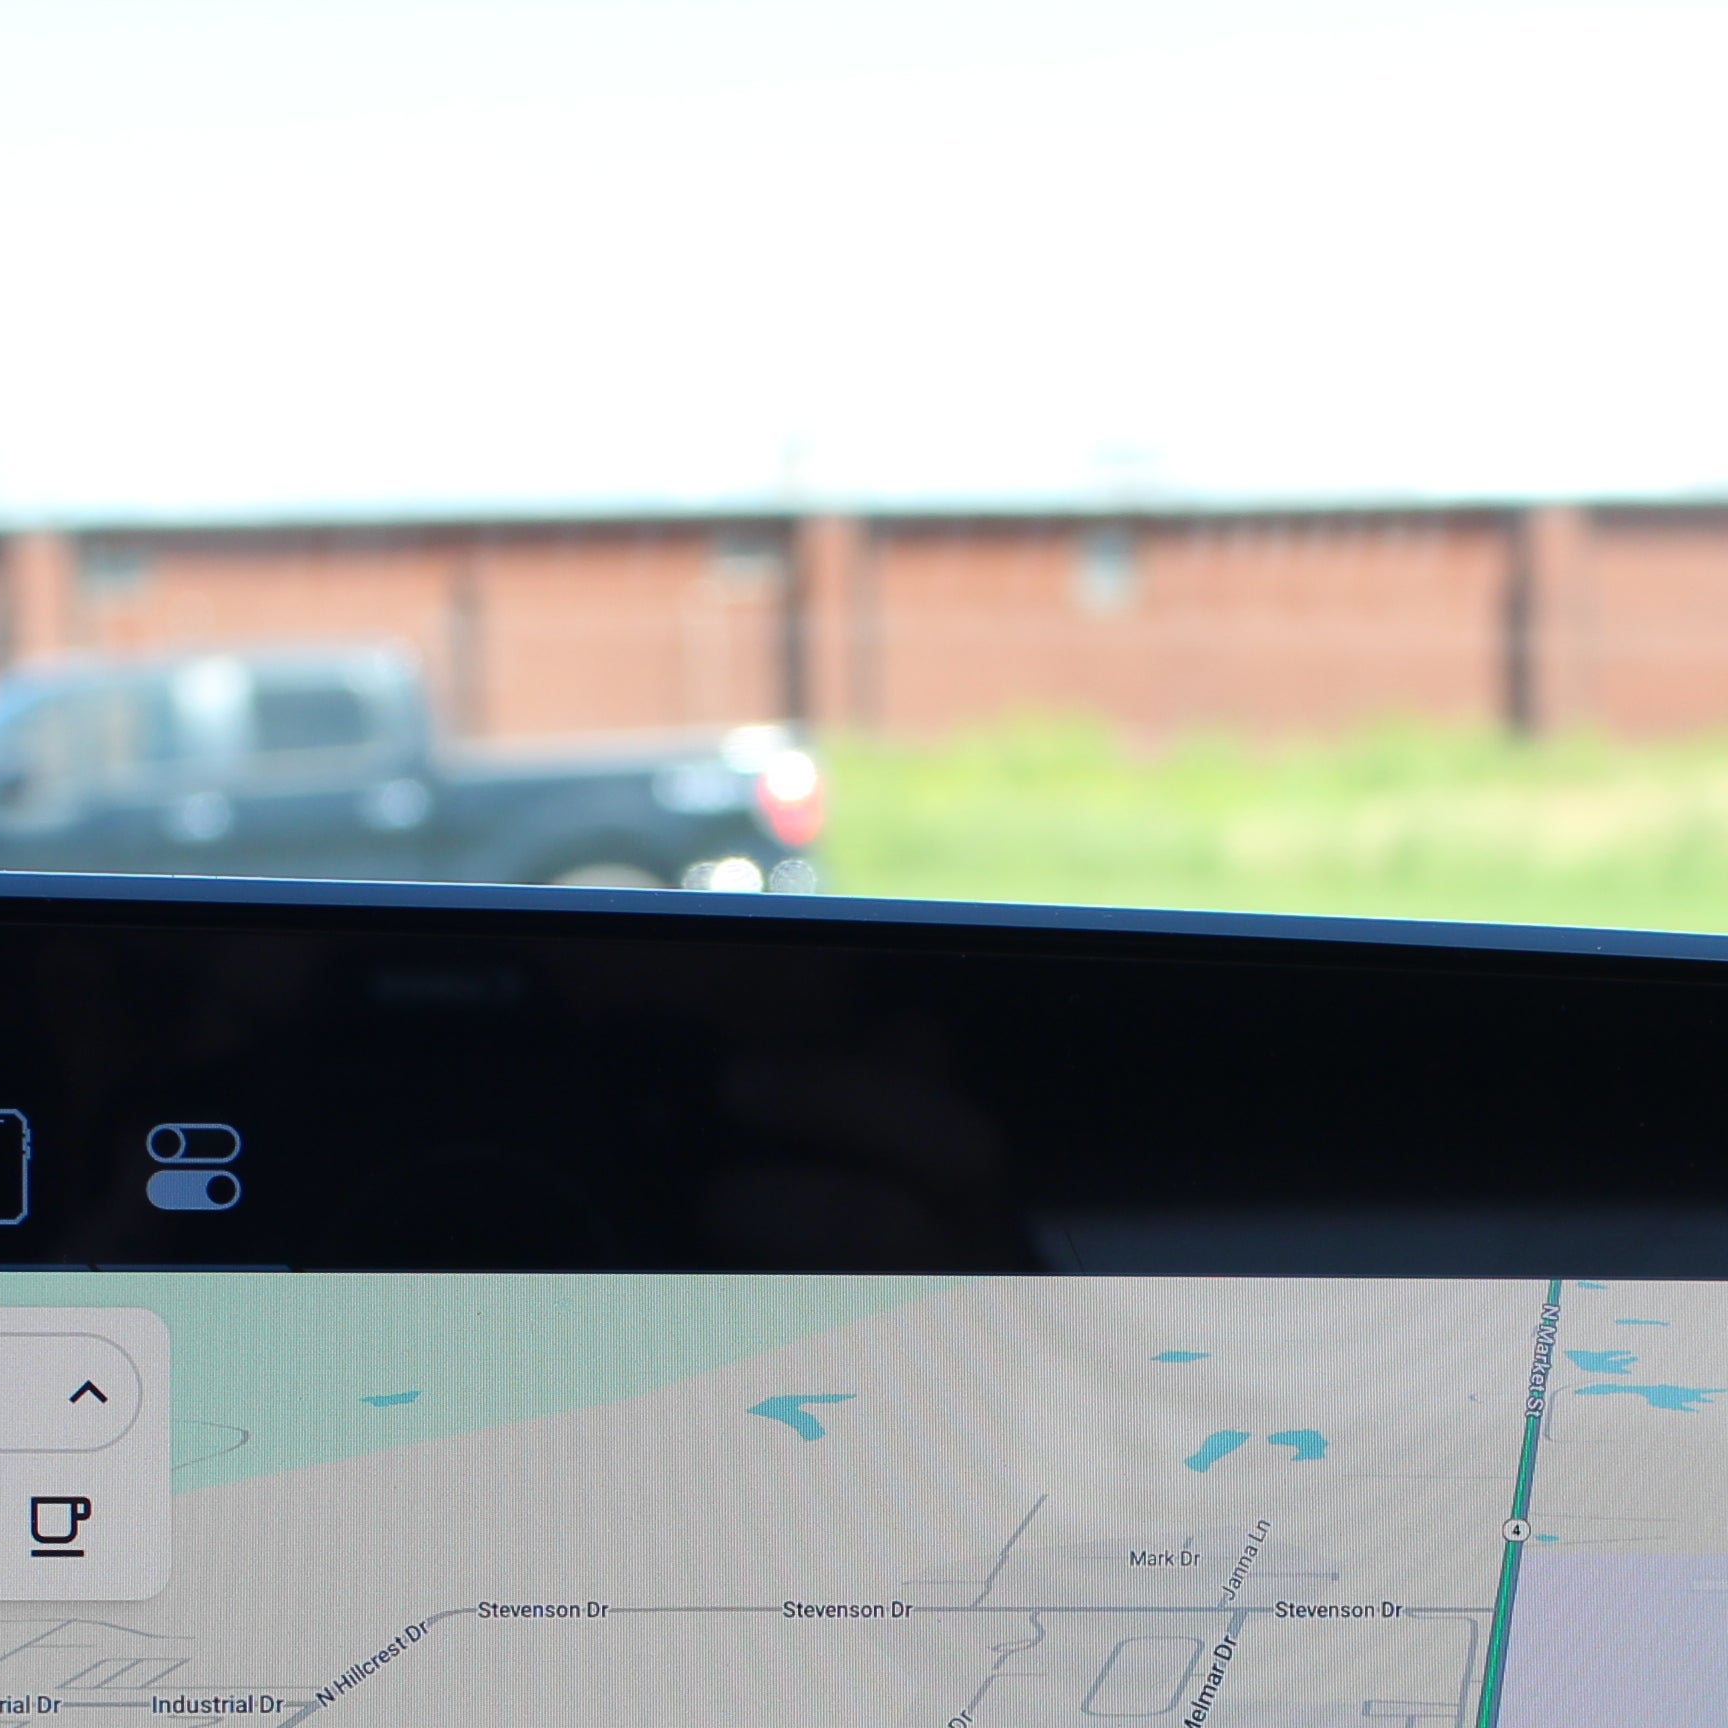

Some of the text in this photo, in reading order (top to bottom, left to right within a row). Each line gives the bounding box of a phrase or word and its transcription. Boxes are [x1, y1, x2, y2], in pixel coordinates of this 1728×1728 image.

[1524, 1302, 1560, 1419] N Market St
[1512, 1525, 1521, 1536] 4
[1129, 1550, 1200, 1566] Mark Dr
[1221, 1518, 1272, 1600] Janna Ln
[477, 1601, 609, 1619] Stevenson Dr
[782, 1601, 913, 1619] Stevenson Dr
[1275, 1601, 1402, 1619] Stevenson Dr
[1213, 1633, 1238, 1663] Dr
[316, 1617, 430, 1708] N Hillcrest Dr
[35, 1693, 61, 1716] Dr
[151, 1694, 284, 1716] Industrial Dr
